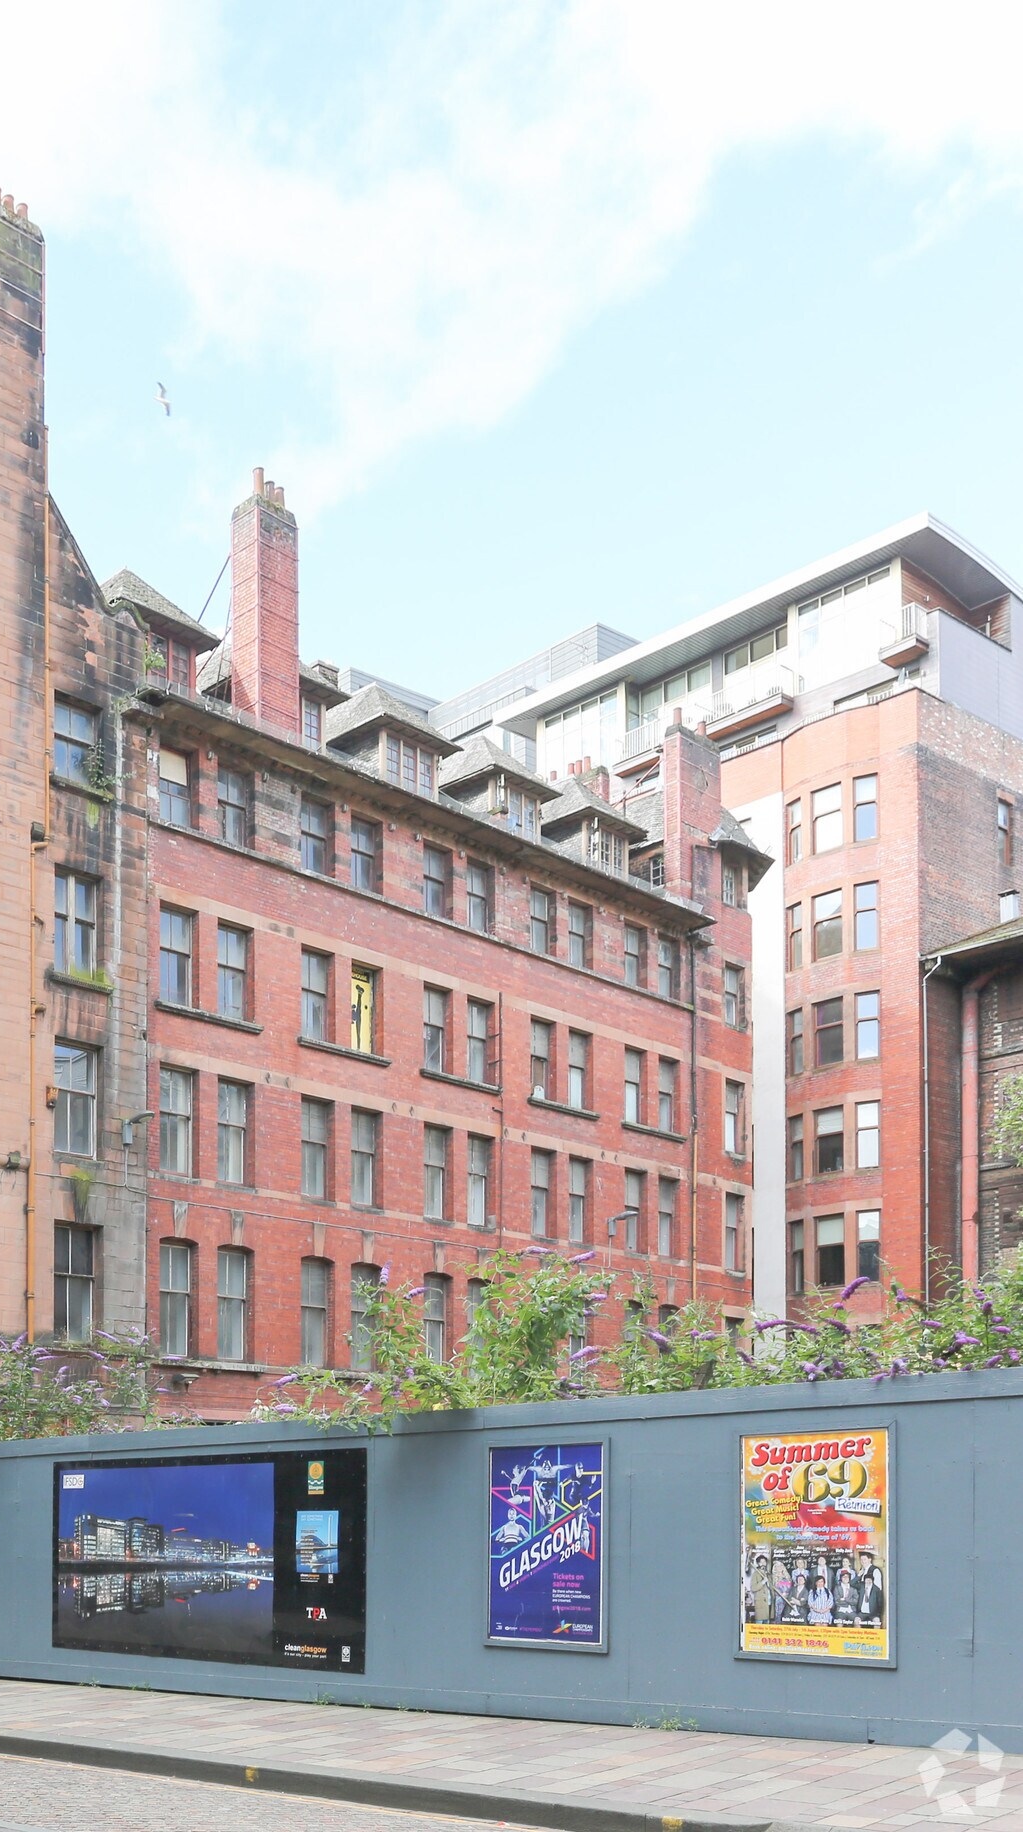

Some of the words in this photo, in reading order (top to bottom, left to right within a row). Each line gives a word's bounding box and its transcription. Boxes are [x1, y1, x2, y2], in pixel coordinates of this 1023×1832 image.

[751, 1437, 871, 1467] Summer
[763, 1466, 792, 1491] of
[792, 1460, 867, 1503] 69
[745, 1500, 768, 1508] Great
[770, 1493, 803, 1505] Comedy!
[751, 1507, 774, 1516] Great
[776, 1503, 799, 1513] Music!
[756, 1514, 780, 1524] Great
[780, 1512, 796, 1522] Fun!
[804, 1525, 829, 1534] Comedy
[499, 1513, 583, 1588] GLASGOW
[559, 1540, 581, 1563] 2018
[553, 1572, 575, 1580] Tickets
[306, 1607, 327, 1620] TPA
[284, 1643, 327, 1654] cleanglasgow
[761, 1637, 782, 1646] 0141
[785, 1638, 803, 1647] 332
[806, 1639, 829, 1648] 1846
